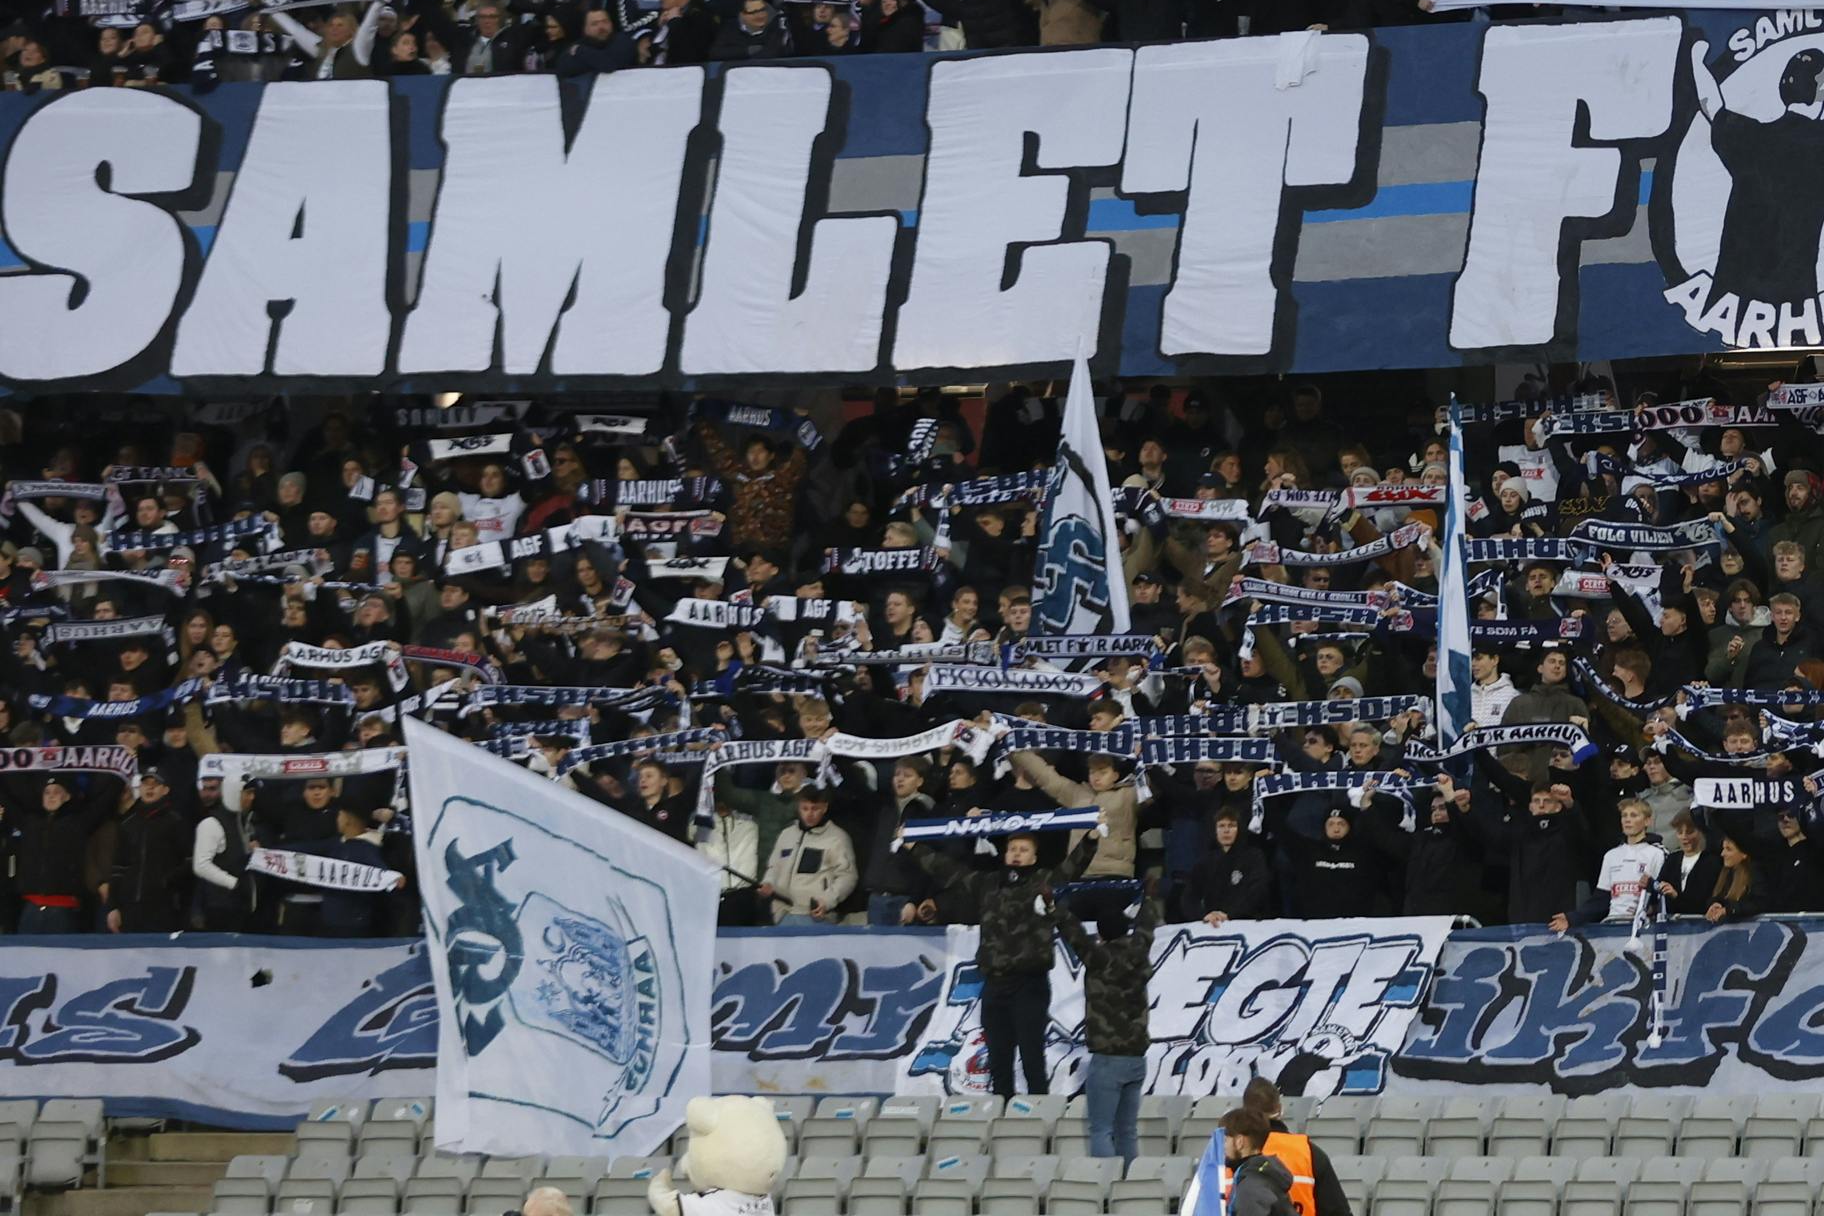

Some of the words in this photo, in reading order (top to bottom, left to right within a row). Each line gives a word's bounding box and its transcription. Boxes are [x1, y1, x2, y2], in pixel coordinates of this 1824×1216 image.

[2, 32, 1372, 382] SAMLET
[727, 405, 771, 426] AARHUS
[619, 479, 676, 504] AARHUS
[510, 534, 543, 558] AGF
[1588, 525, 1625, 542] FØLG
[1630, 527, 1674, 545] VILJEN
[1297, 541, 1386, 567] AARHUS
[1581, 577, 1611, 591] CERES
[688, 602, 766, 626] AARHUS
[803, 597, 832, 619] AGF
[88, 699, 139, 718] AARHUS
[1506, 724, 1581, 746] AARHUS
[778, 740, 816, 758] AGF
[1713, 780, 1795, 805] AARHUS
